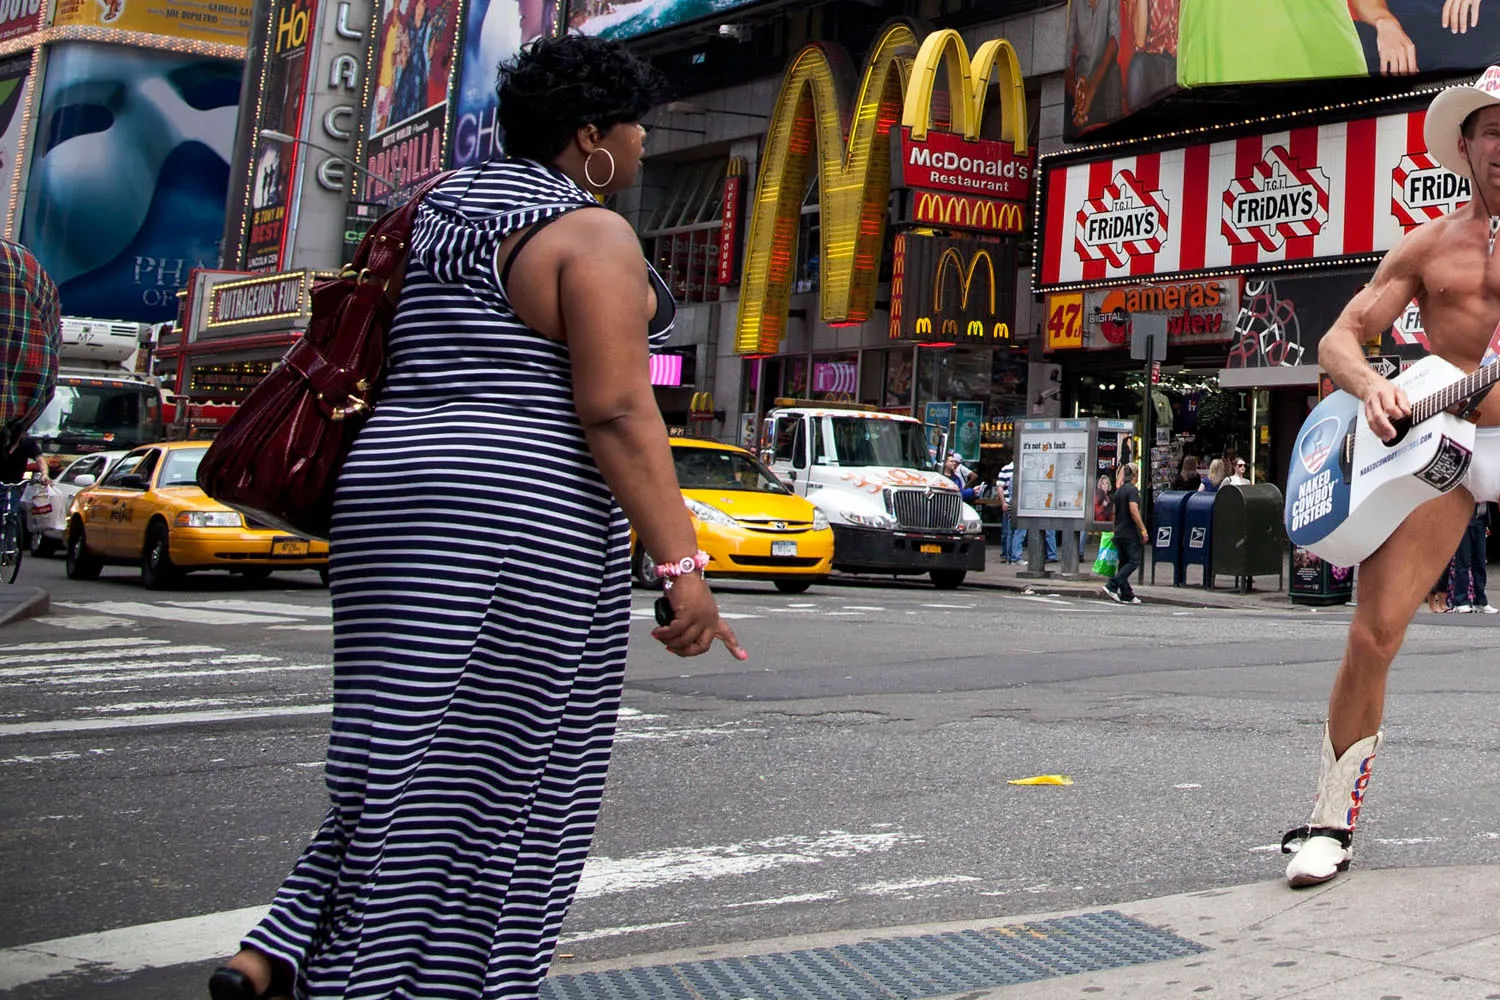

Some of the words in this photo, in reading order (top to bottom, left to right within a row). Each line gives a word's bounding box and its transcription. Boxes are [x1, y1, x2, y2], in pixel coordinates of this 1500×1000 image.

[909, 146, 1028, 180] McDonald's
[929, 171, 1009, 192] Restaurant
[1265, 178, 1285, 191] T.G.I.
[726, 183, 734, 219] OPEN
[1113, 199, 1131, 211] T.G.I.
[250, 220, 280, 243] BEST
[721, 233, 730, 279] HOURS
[218, 281, 276, 321] OUTRAGEOUS
[277, 278, 300, 313] FUN!
[1089, 312, 1123, 324] DIGITAL
[77, 332, 95, 342] M7
[1107, 420, 1125, 429] TITAN
[1032, 442, 1041, 450] not
[1298, 469, 1331, 499] NAKED
[1291, 480, 1335, 517] COWBOY
[1291, 497, 1333, 532] OYSTERS
